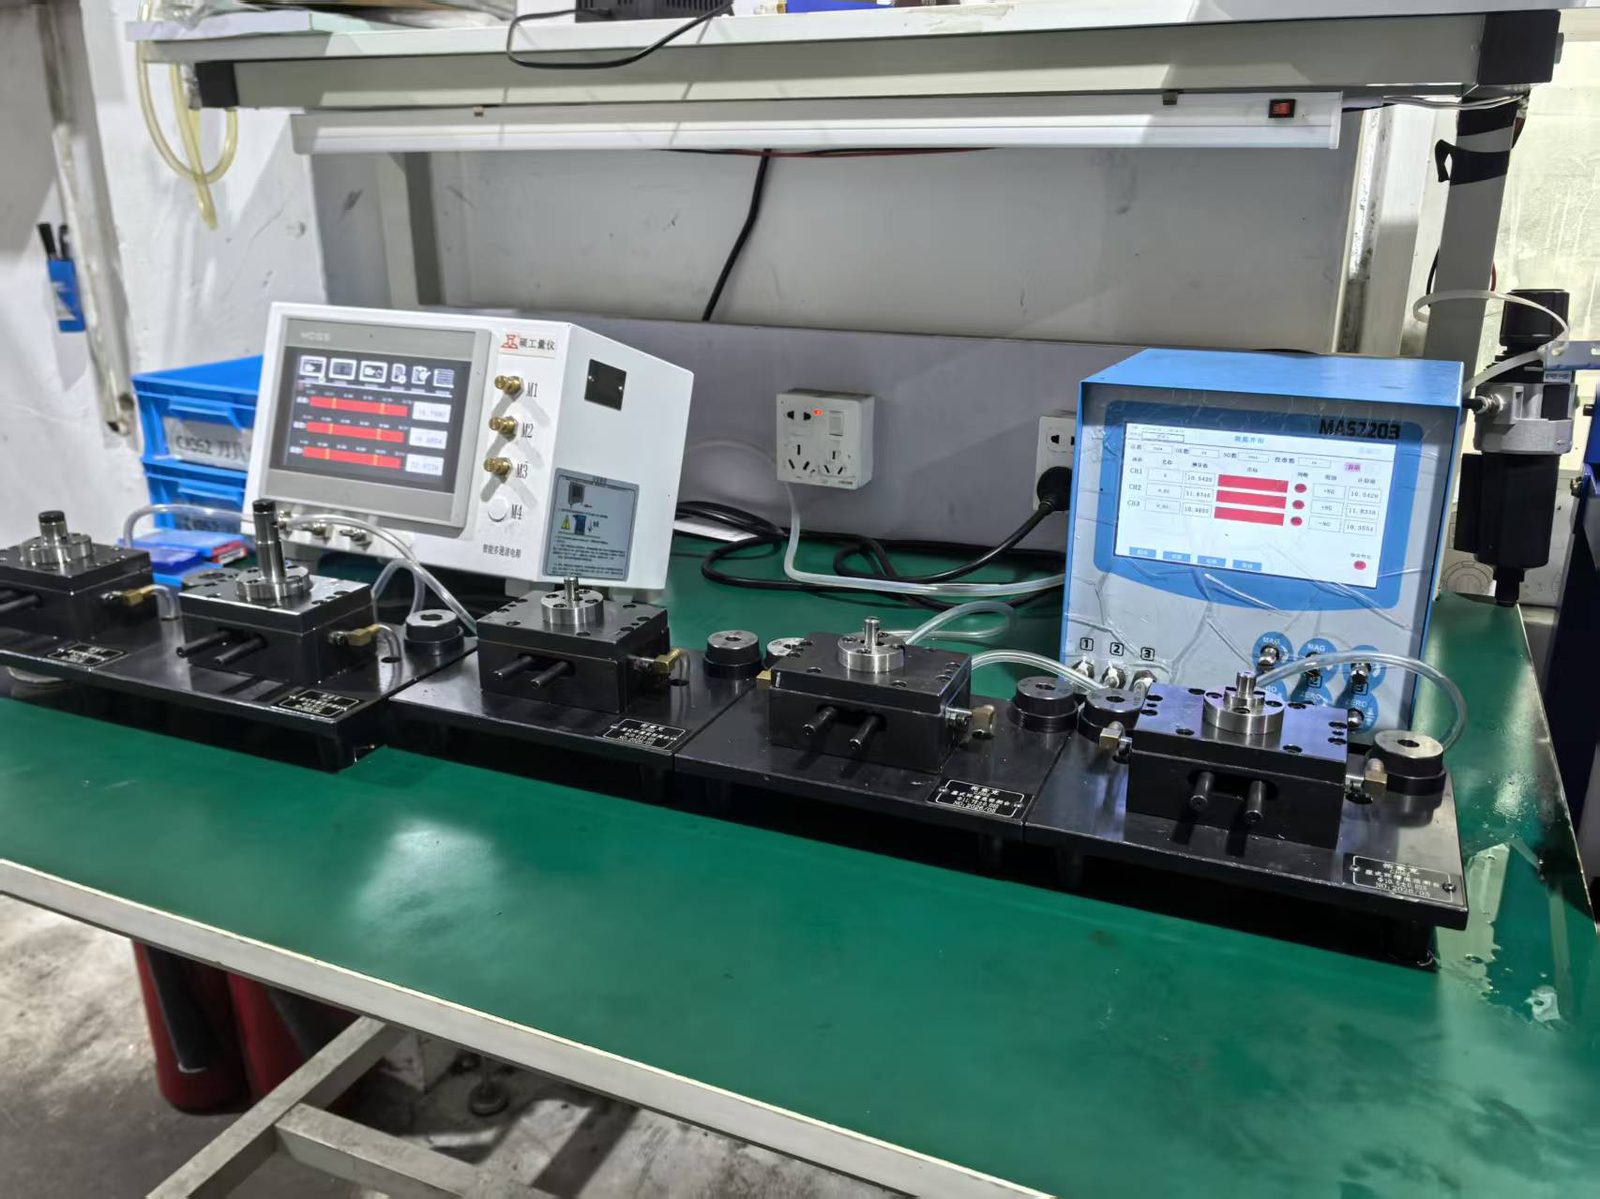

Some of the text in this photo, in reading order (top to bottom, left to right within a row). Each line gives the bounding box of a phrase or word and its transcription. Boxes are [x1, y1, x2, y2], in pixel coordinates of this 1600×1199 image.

[526, 382, 538, 398] M1
[521, 423, 534, 438] M2
[516, 463, 528, 480] M3
[511, 503, 523, 520] M4
[1307, 643, 1326, 651] MAG
